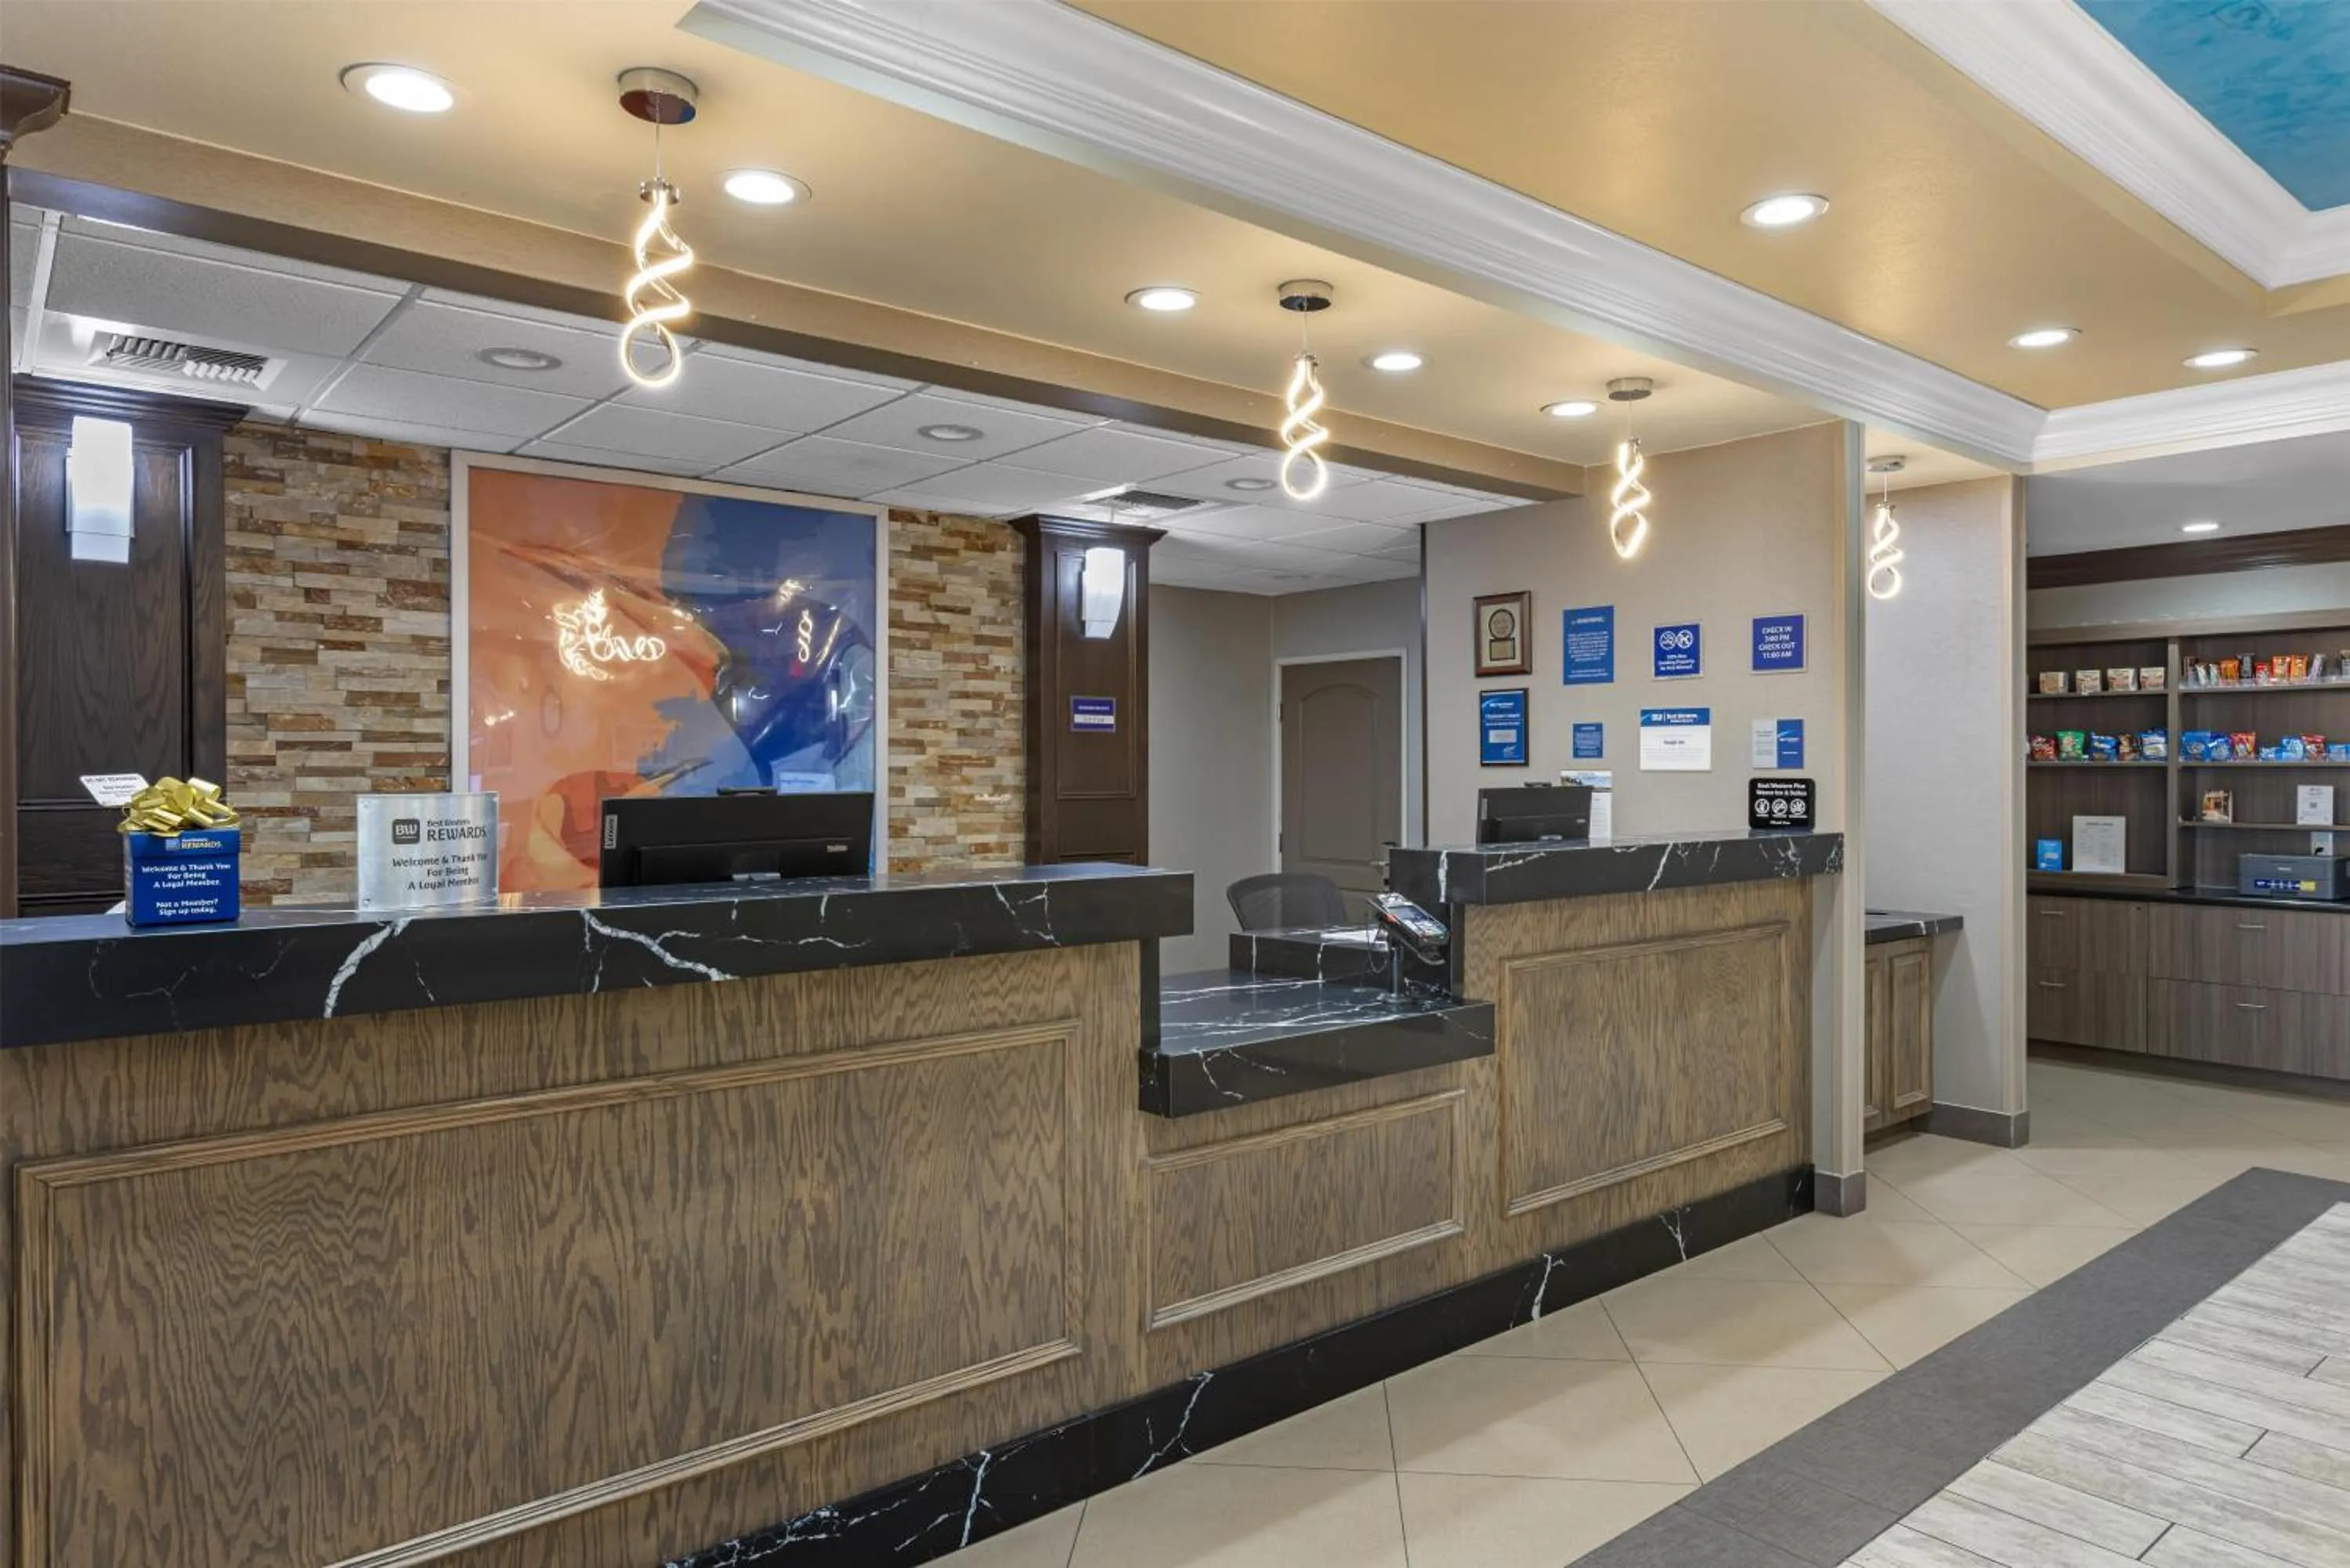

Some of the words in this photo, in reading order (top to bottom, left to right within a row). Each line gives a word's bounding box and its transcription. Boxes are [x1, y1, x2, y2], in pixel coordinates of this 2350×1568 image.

[395, 822, 418, 836] BW
[427, 826, 487, 841] REWARDS
[392, 857, 439, 867] Welcome
[441, 855, 449, 864] &
[451, 854, 475, 863] Thank
[427, 869, 443, 877] For
[445, 867, 469, 876] Being
[162, 880, 184, 889] Loyal
[407, 881, 416, 891] A
[418, 880, 446, 891] Loyal
[181, 898, 219, 907] Member?
